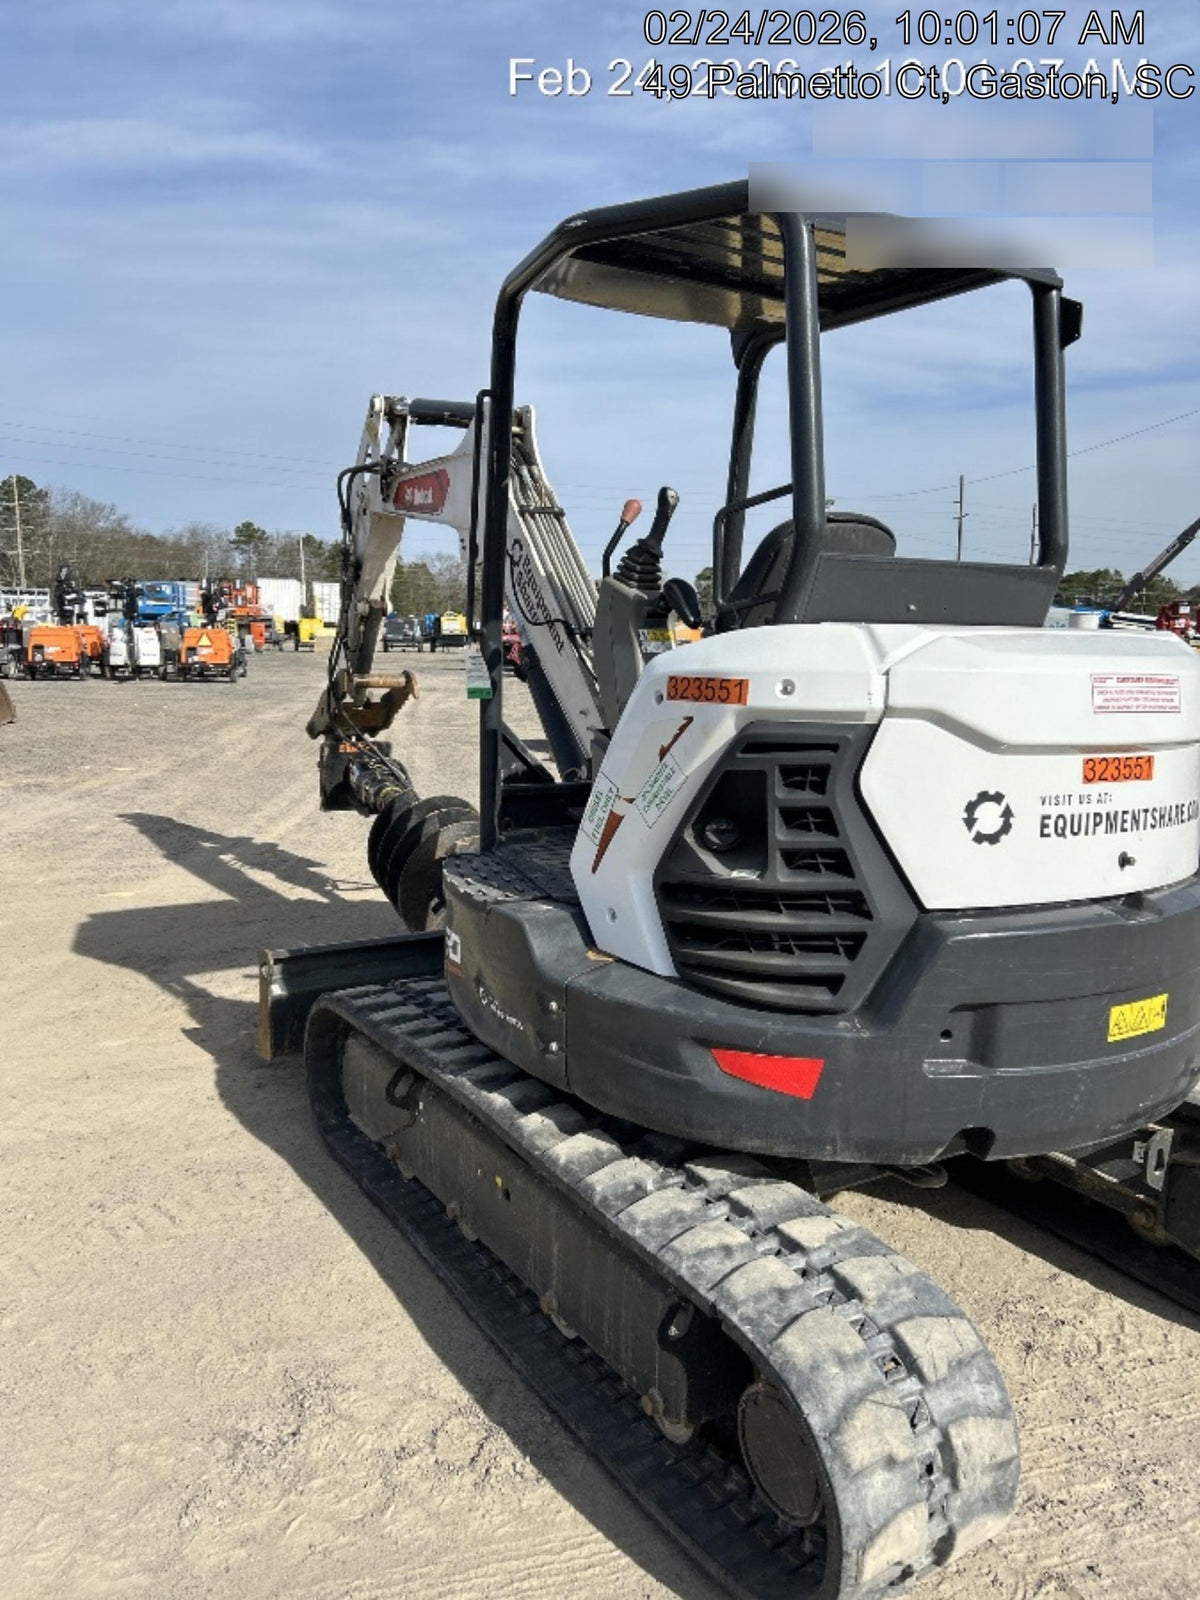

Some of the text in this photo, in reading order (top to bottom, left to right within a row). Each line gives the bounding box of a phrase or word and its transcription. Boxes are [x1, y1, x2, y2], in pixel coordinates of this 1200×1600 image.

[668, 676, 744, 704] 323551
[1084, 755, 1152, 783] 323551
[1040, 792, 1113, 806] VISIT US AT:
